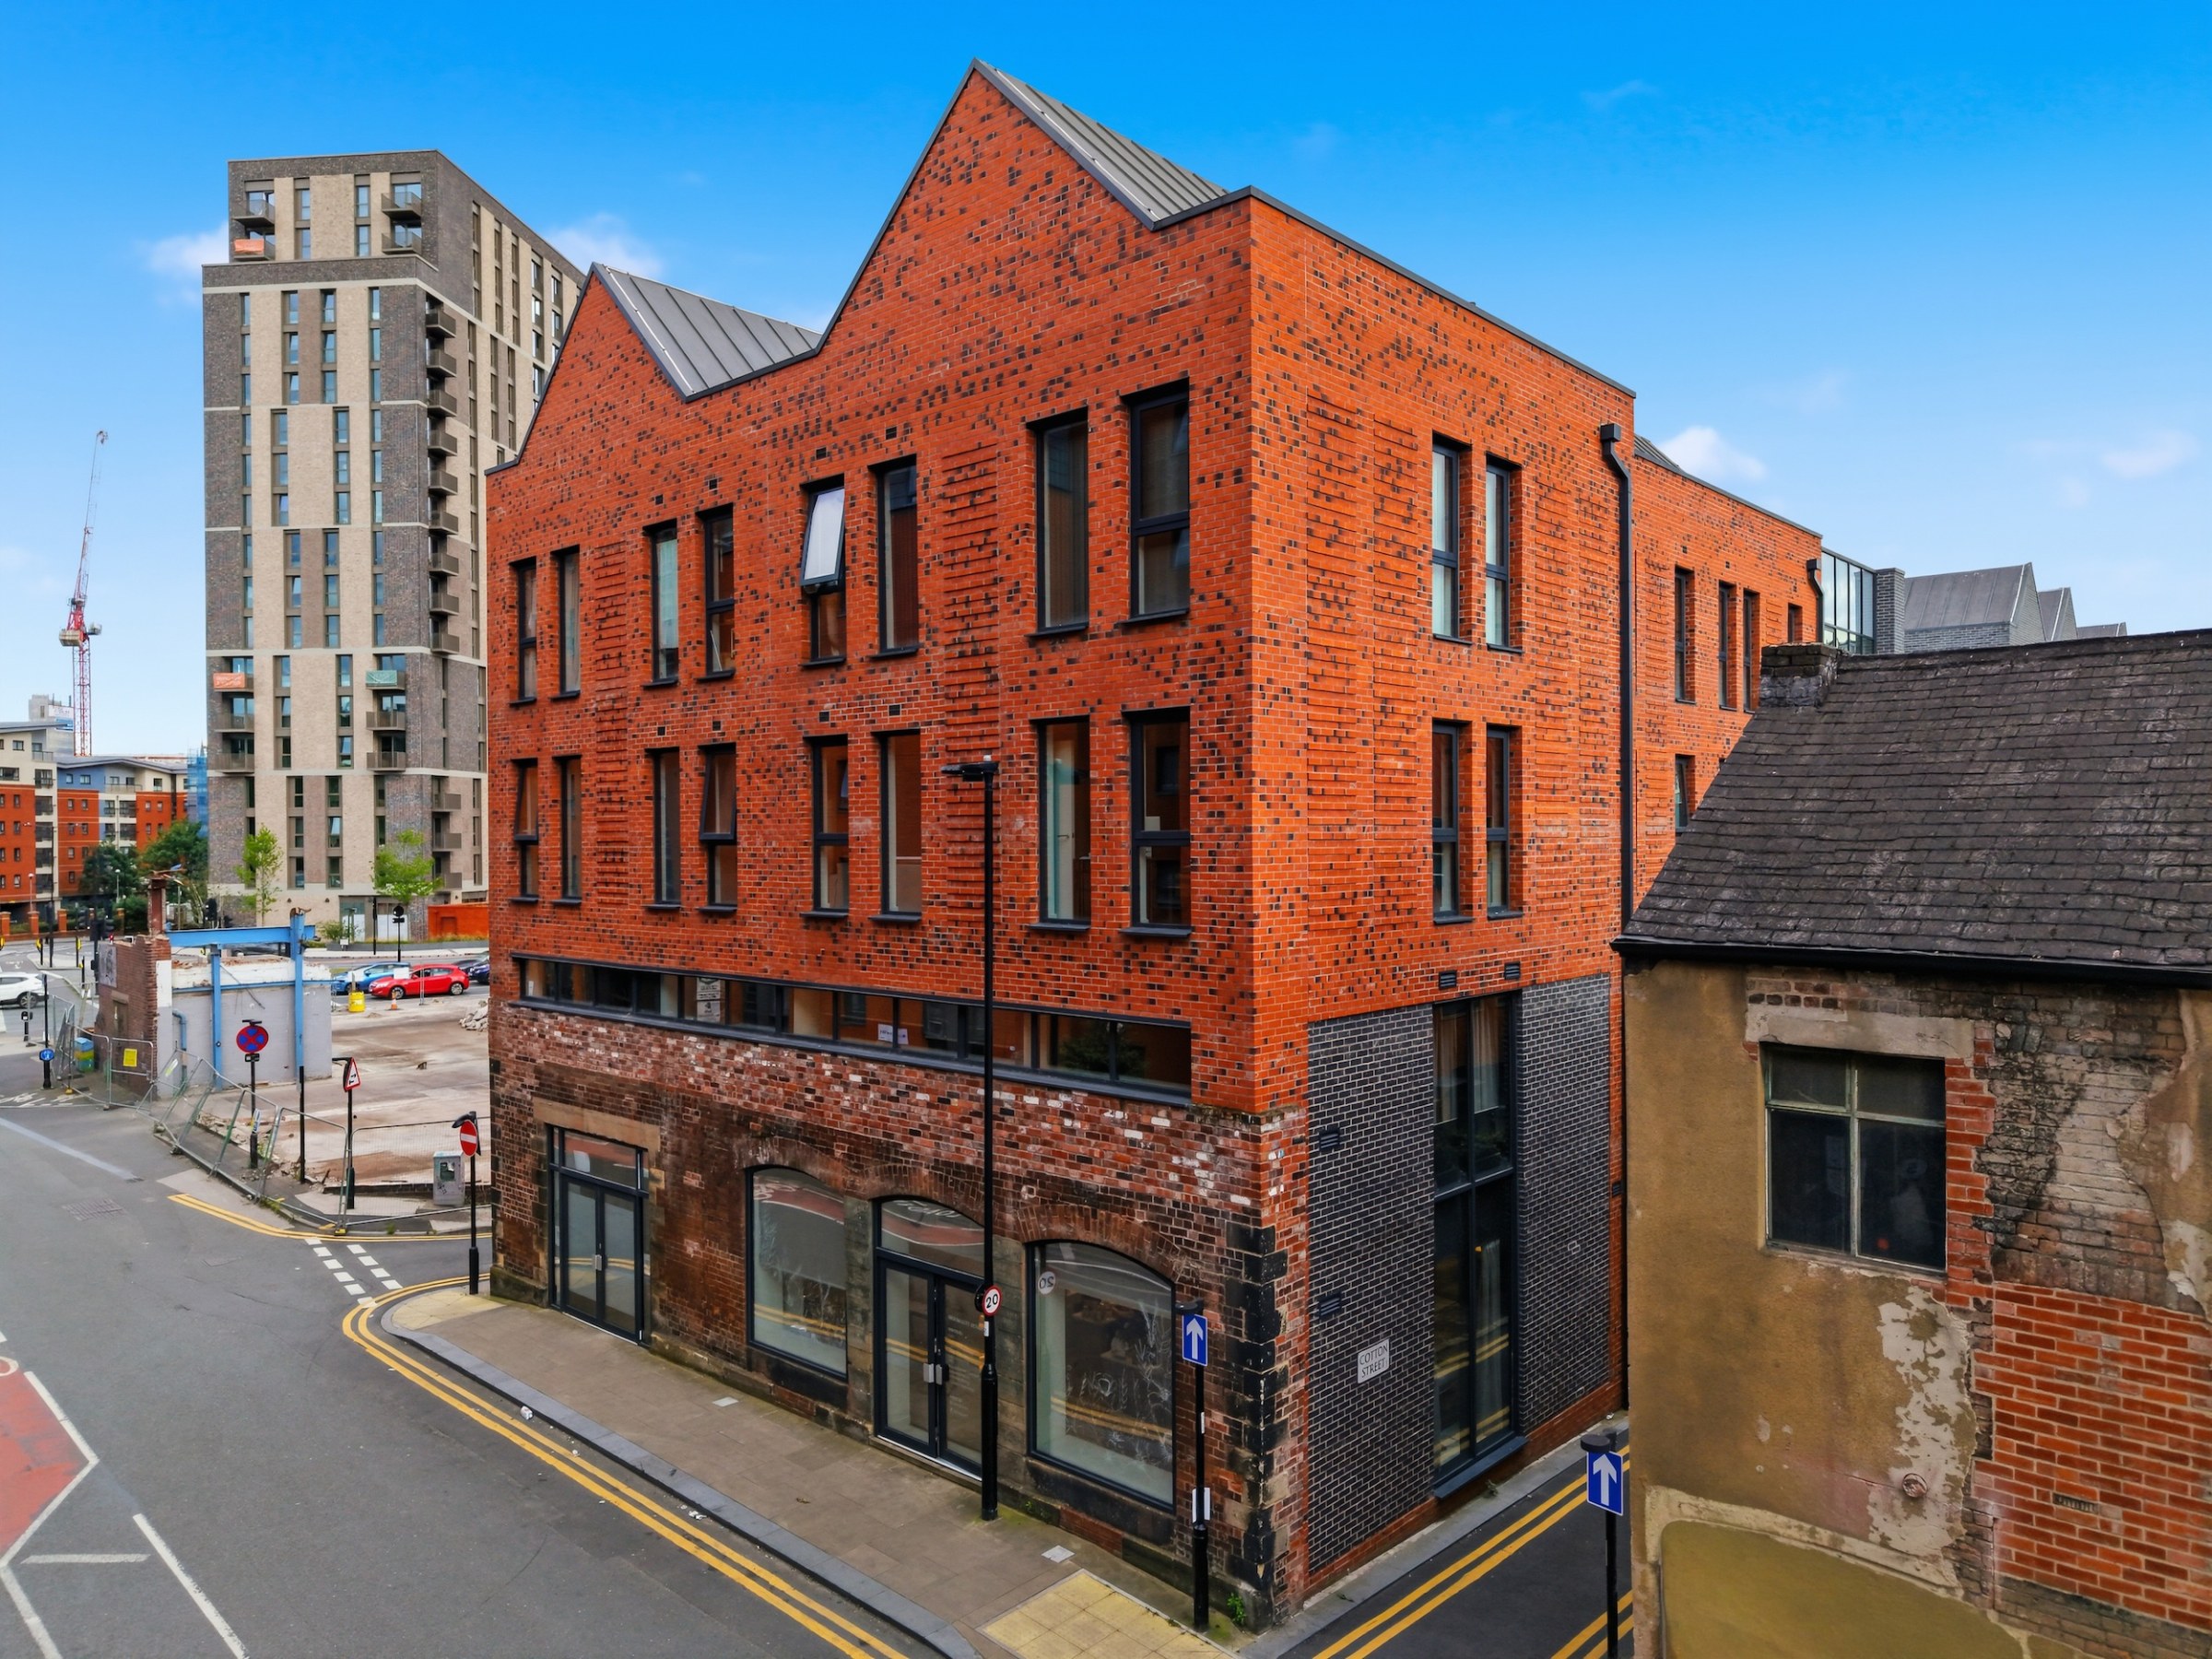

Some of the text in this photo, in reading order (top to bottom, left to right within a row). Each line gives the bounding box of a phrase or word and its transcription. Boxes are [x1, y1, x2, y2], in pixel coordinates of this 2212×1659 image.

[986, 1294, 998, 1309] 20
[1359, 1343, 1387, 1365] COTTON
[1362, 1358, 1385, 1378] STREET
